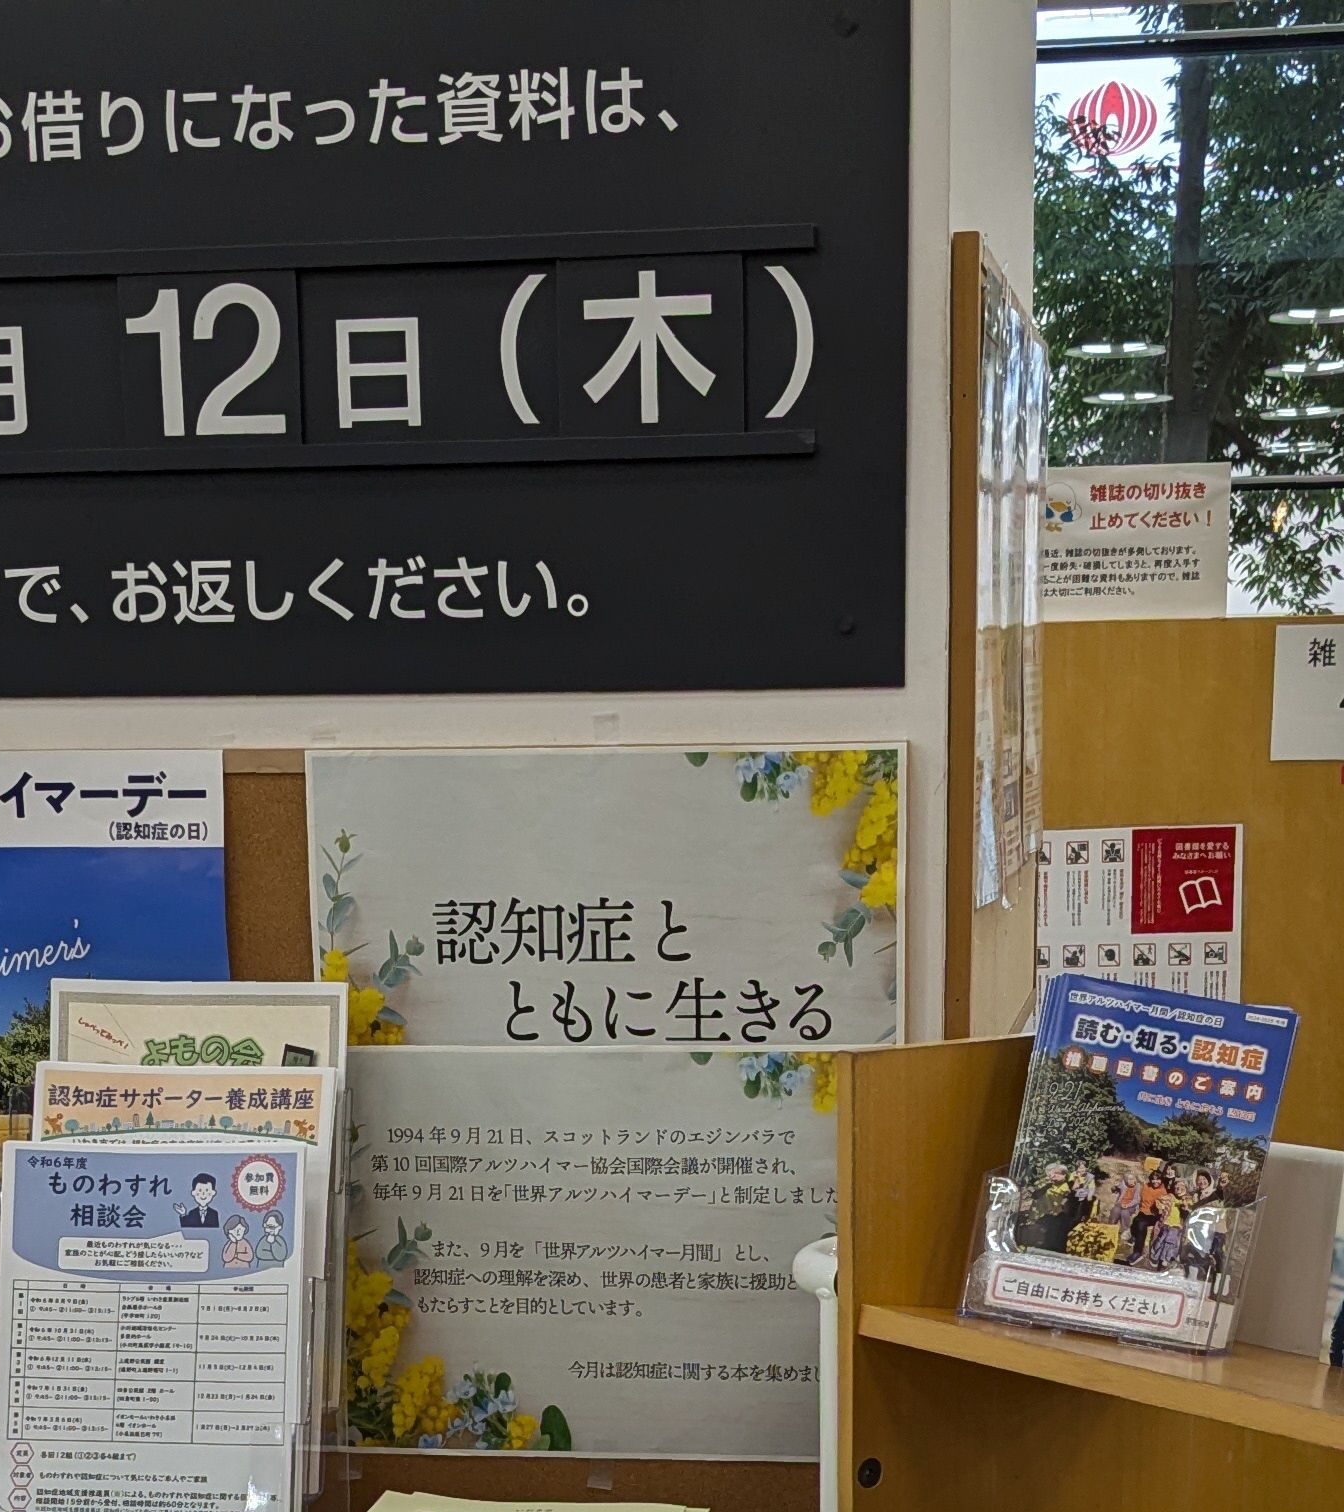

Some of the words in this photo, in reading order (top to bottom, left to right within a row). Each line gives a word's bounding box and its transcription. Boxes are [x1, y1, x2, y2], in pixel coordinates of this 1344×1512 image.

[1090, 482, 1206, 502] 雑誌の切り抜き
[107, 820, 209, 842] (認知症の日)
[431, 896, 692, 965] 認知症と
[506, 977, 832, 1044] ともに生きる
[48, 1084, 314, 1110] 認知症サポーター養成講座
[27, 1156, 88, 1170] 令和6年度
[48, 1172, 173, 1196] ものわすれ
[70, 1204, 146, 1228] 相談会
[418, 1296, 644, 1318] もたらすことを目的としています。
[1002, 1276, 1167, 1316] ご自由にお持ちください
